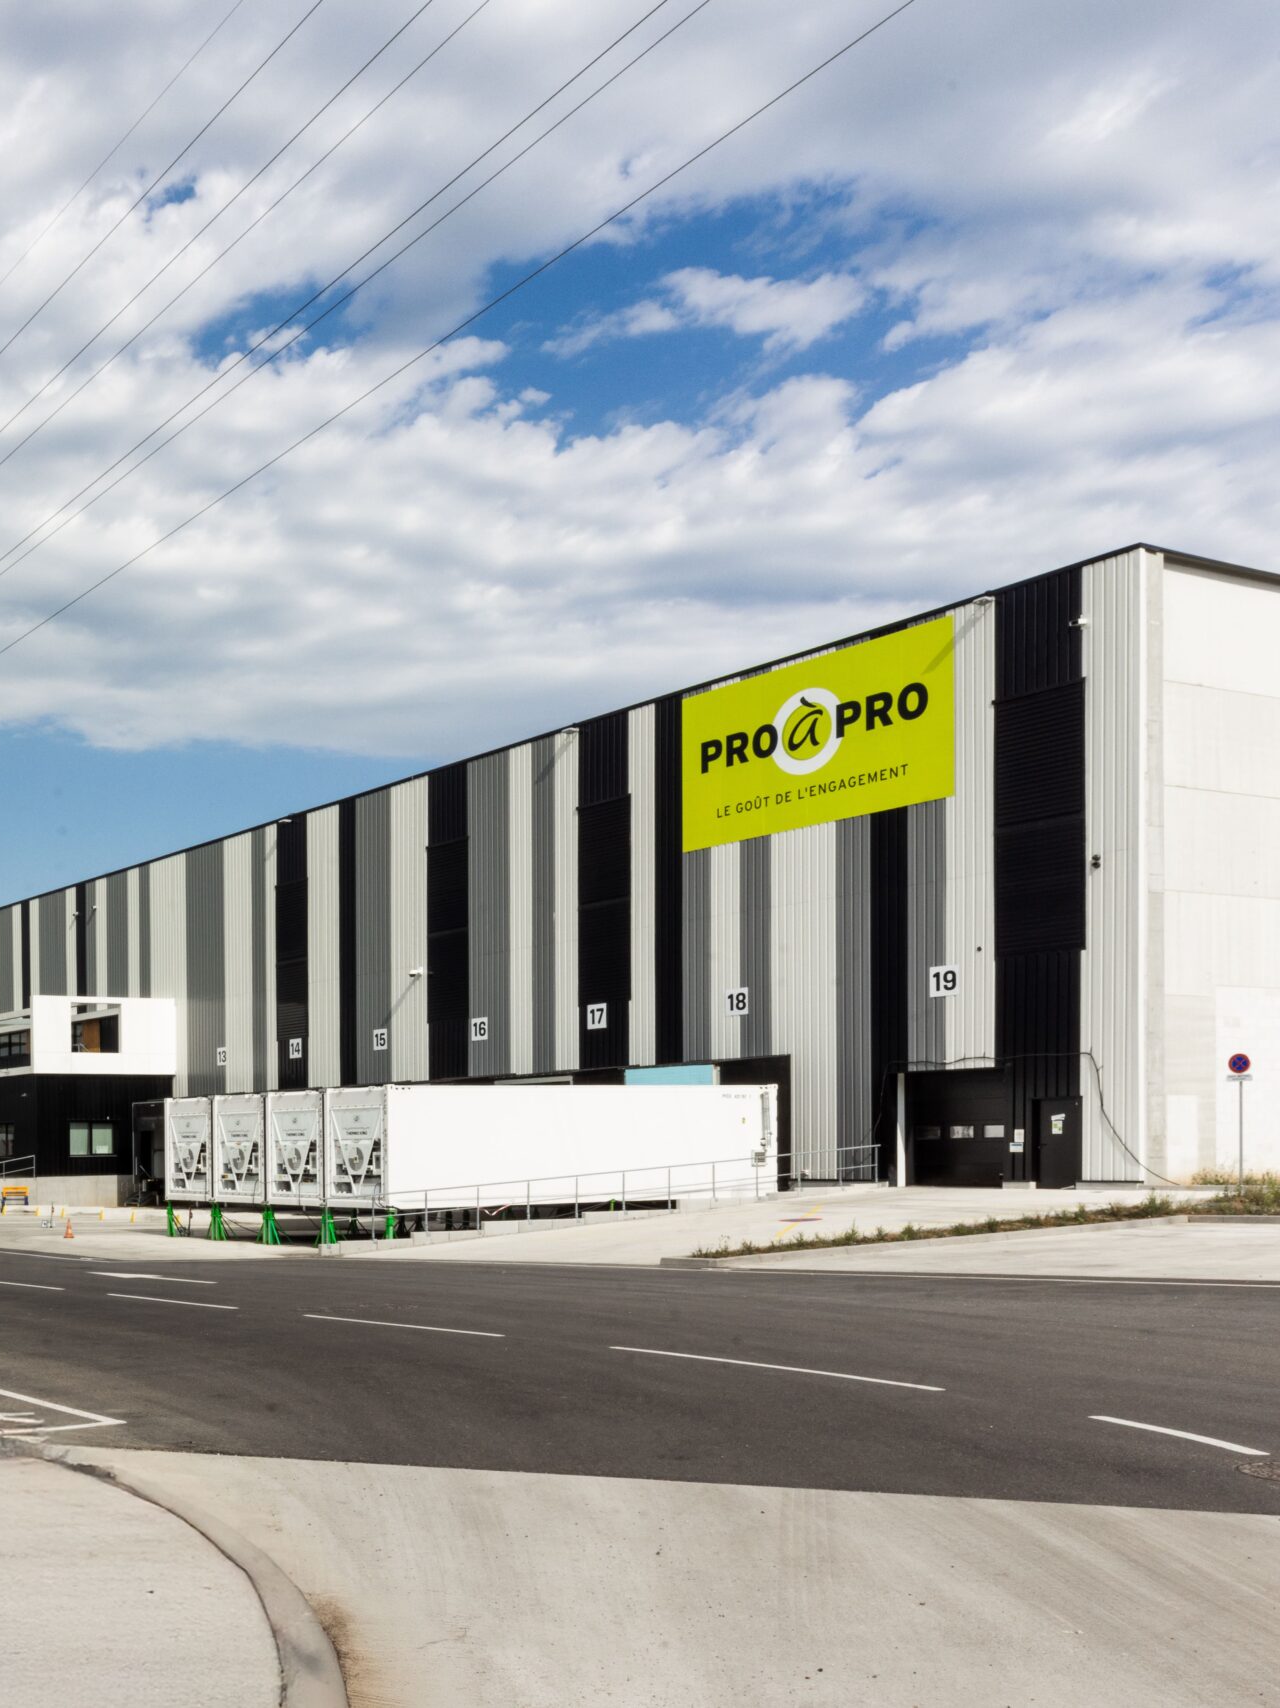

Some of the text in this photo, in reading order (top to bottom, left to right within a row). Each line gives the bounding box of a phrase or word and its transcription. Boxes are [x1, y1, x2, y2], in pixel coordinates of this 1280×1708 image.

[700, 724, 778, 775] PRO
[835, 682, 929, 739] PRO
[716, 763, 909, 819] LE GOÛT DE L'ENGAGEMENT
[932, 970, 958, 992] 19
[727, 991, 747, 1011] 18
[589, 1007, 606, 1026] 17
[373, 1031, 387, 1048] 15
[471, 1021, 487, 1039] 16
[217, 1049, 227, 1064] 13
[289, 1040, 302, 1056] 14
